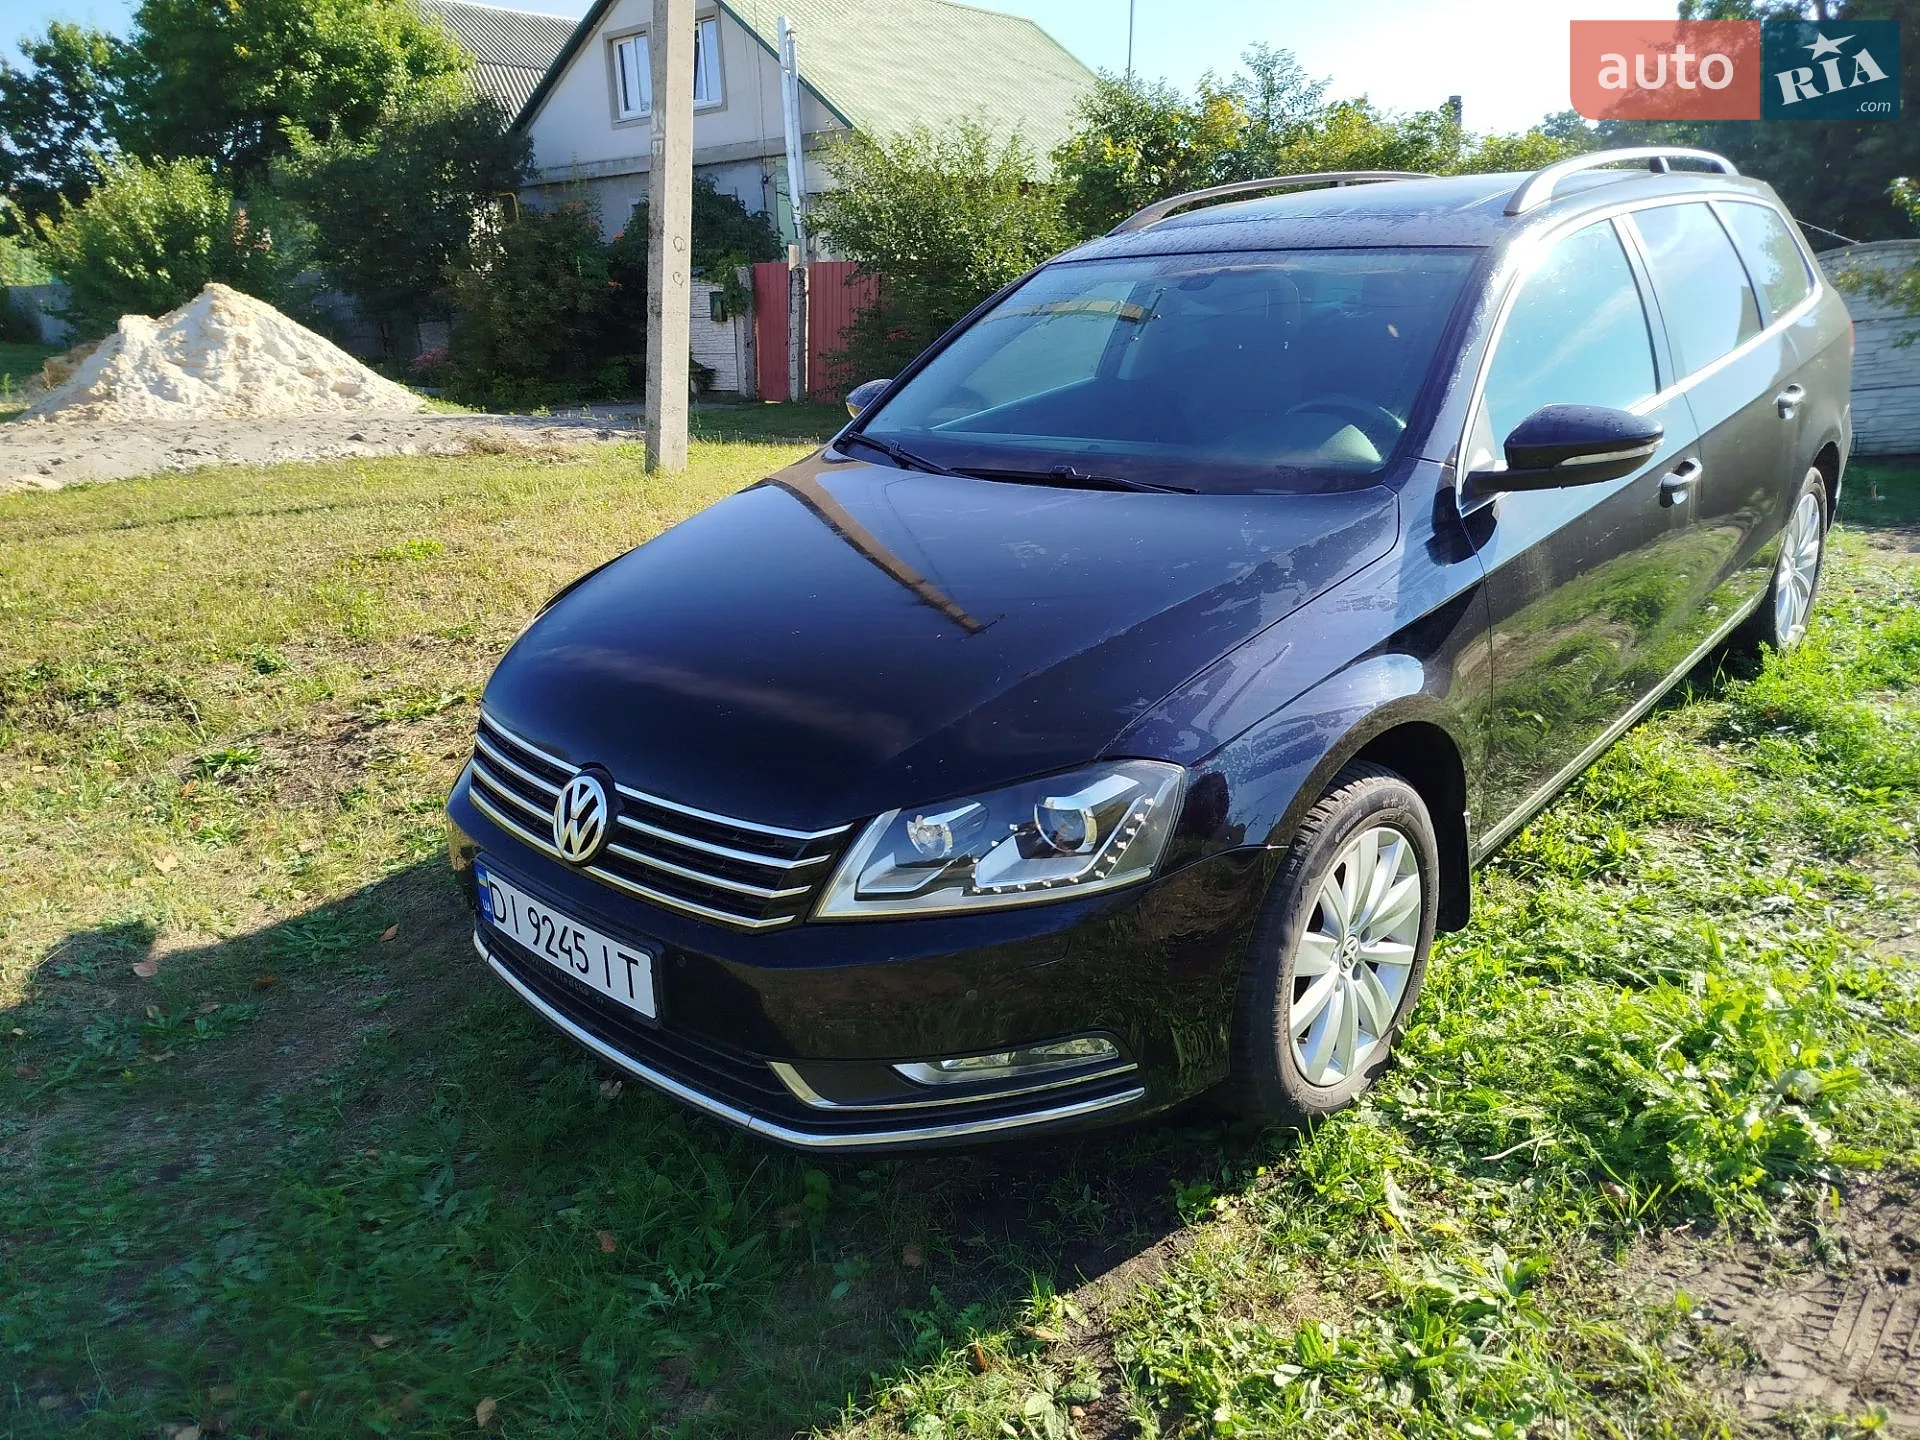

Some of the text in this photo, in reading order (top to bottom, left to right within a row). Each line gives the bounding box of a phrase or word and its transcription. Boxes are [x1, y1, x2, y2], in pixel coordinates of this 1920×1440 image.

[489, 881, 519, 935] DI
[527, 906, 590, 974] 9245
[603, 945, 640, 999] IT
